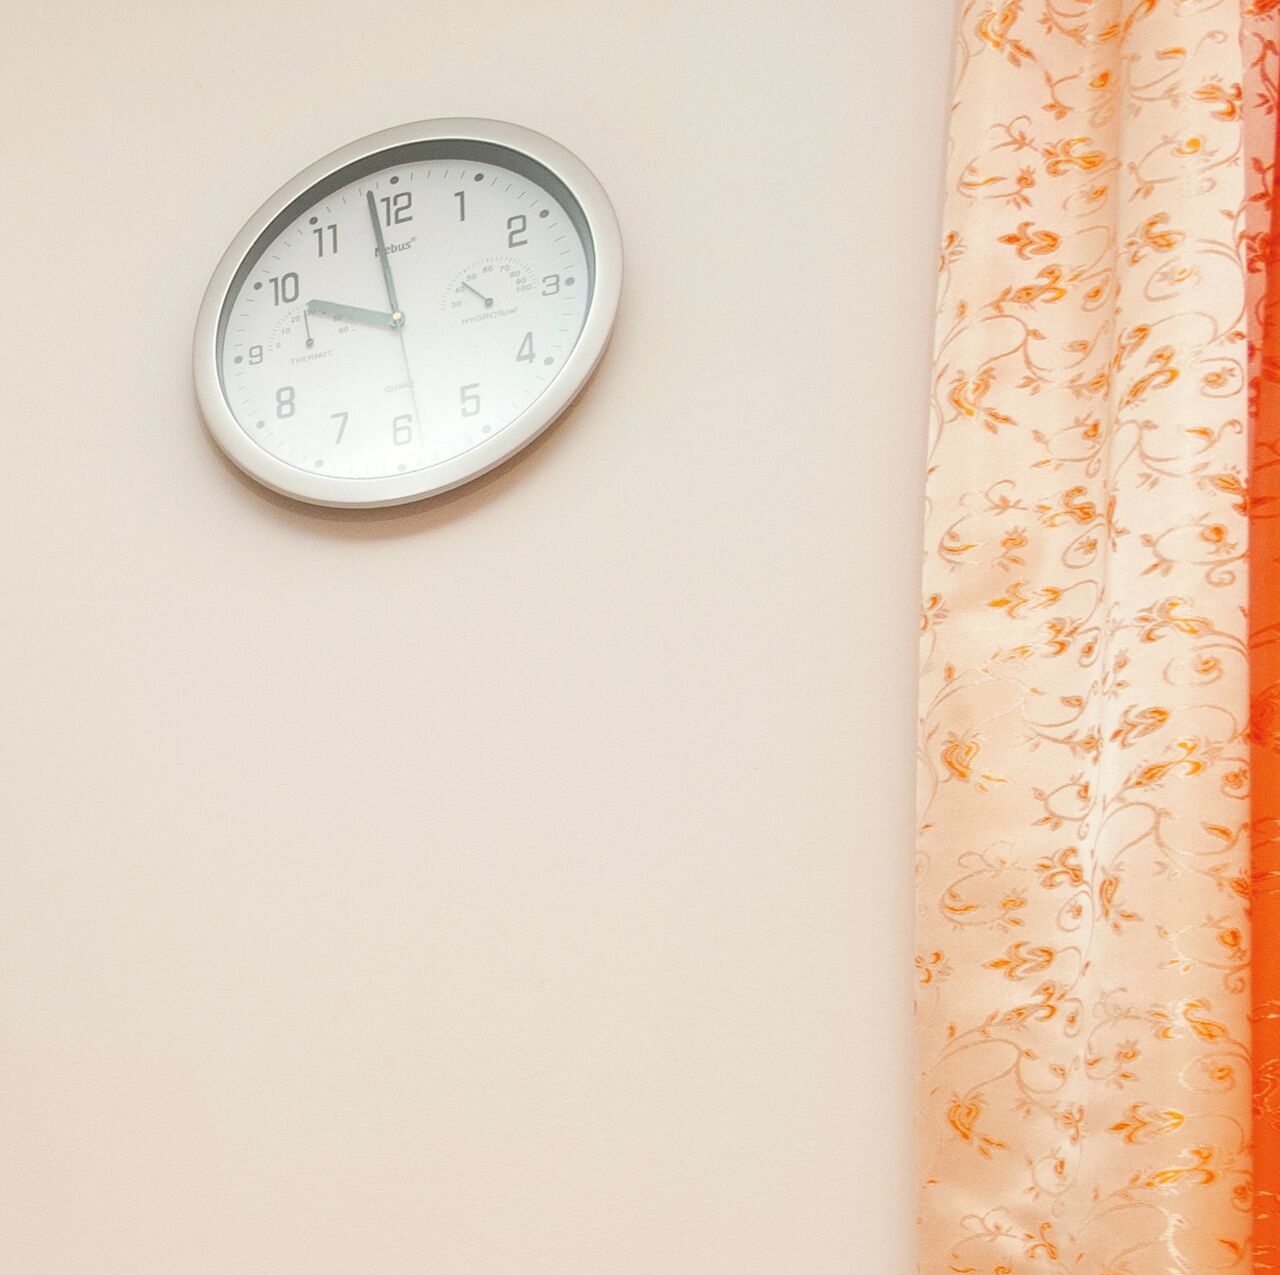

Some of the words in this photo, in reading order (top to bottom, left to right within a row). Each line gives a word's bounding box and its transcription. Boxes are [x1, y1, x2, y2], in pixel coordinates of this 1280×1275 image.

[380, 191, 413, 227] 12
[453, 190, 466, 222] 1
[312, 224, 339, 258] 11
[506, 215, 529, 249] 2
[268, 271, 300, 306] 10
[541, 273, 560, 297] 3
[247, 344, 264, 367] 9
[515, 331, 537, 364] 4
[275, 385, 296, 420] 8
[459, 382, 481, 418] 5
[330, 411, 349, 445] 7
[392, 413, 413, 446] 6
